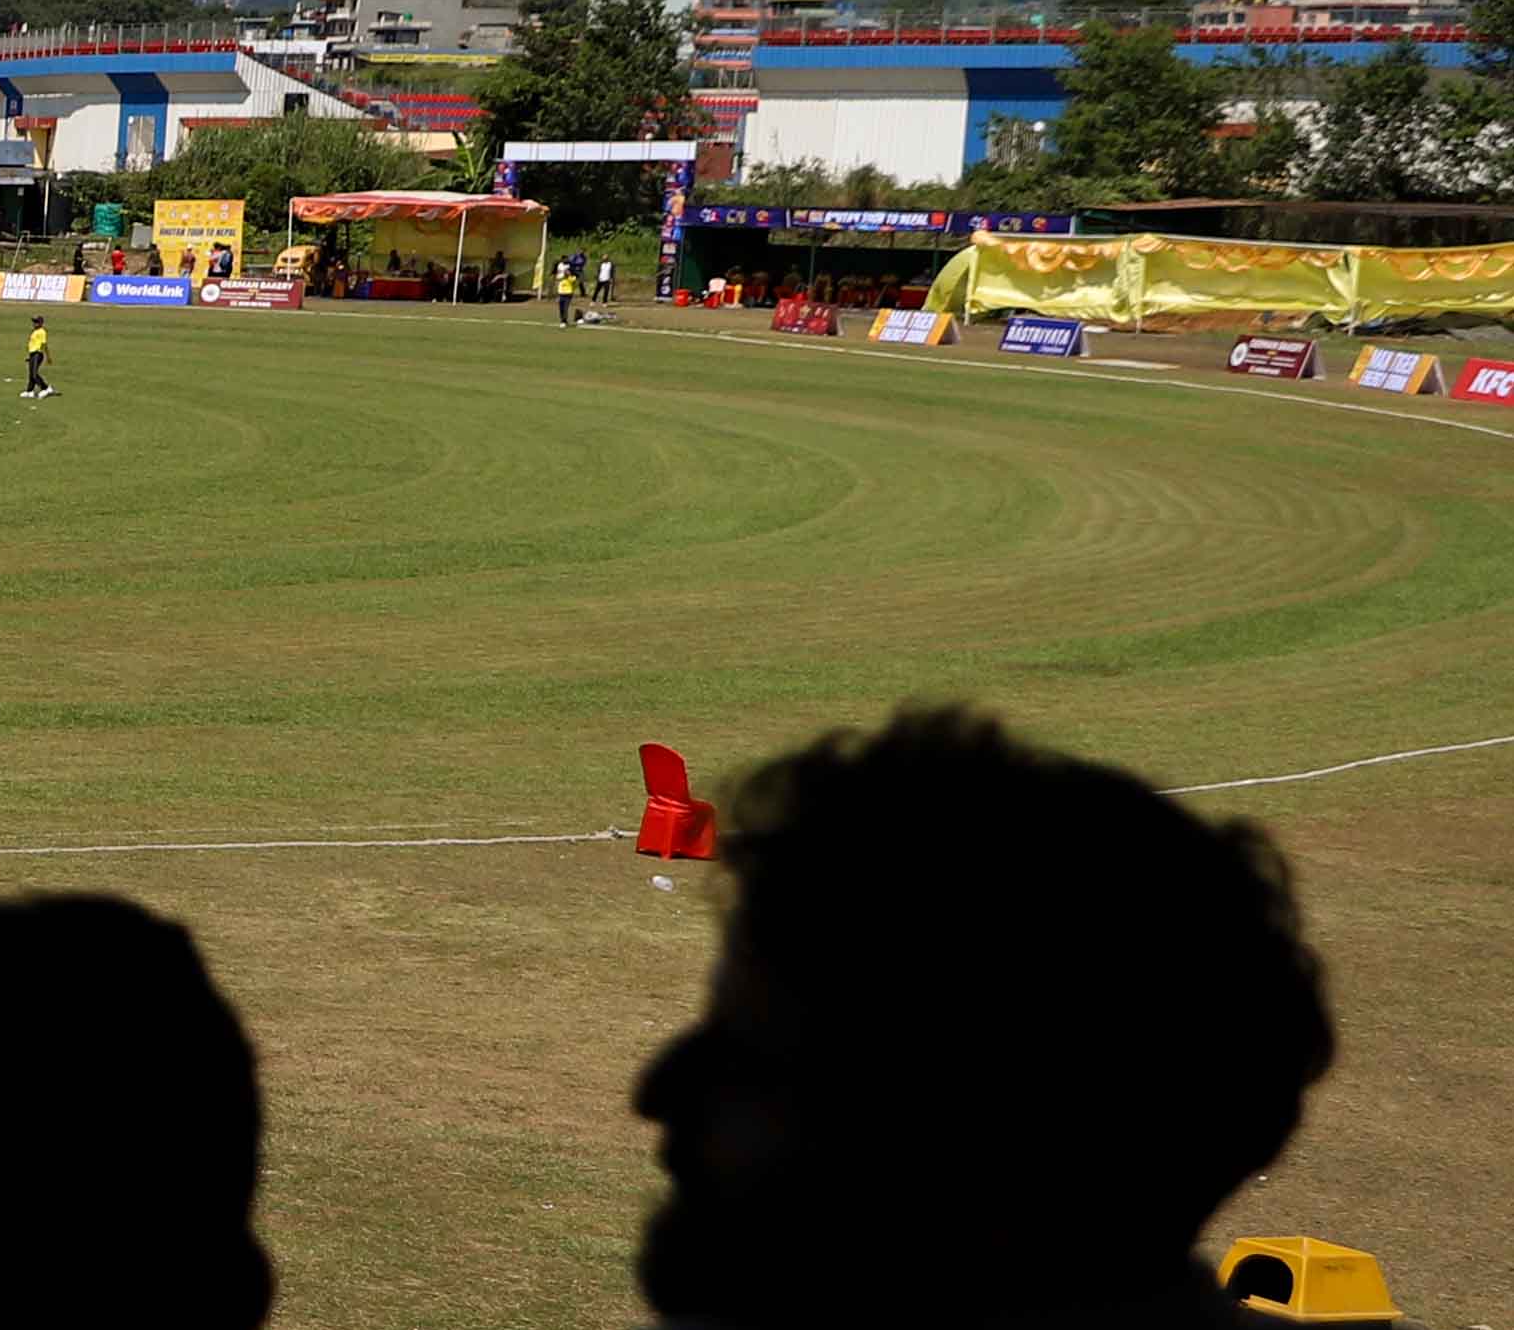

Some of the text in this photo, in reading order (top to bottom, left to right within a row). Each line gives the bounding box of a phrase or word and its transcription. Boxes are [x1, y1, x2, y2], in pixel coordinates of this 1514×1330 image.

[5, 272, 67, 289] MAX TIGER
[220, 280, 294, 290] GERMAN BAKERY
[116, 284, 184, 298] WorldLink
[1006, 326, 1072, 345] RASTRIYATA
[1466, 368, 1514, 398] KFC
